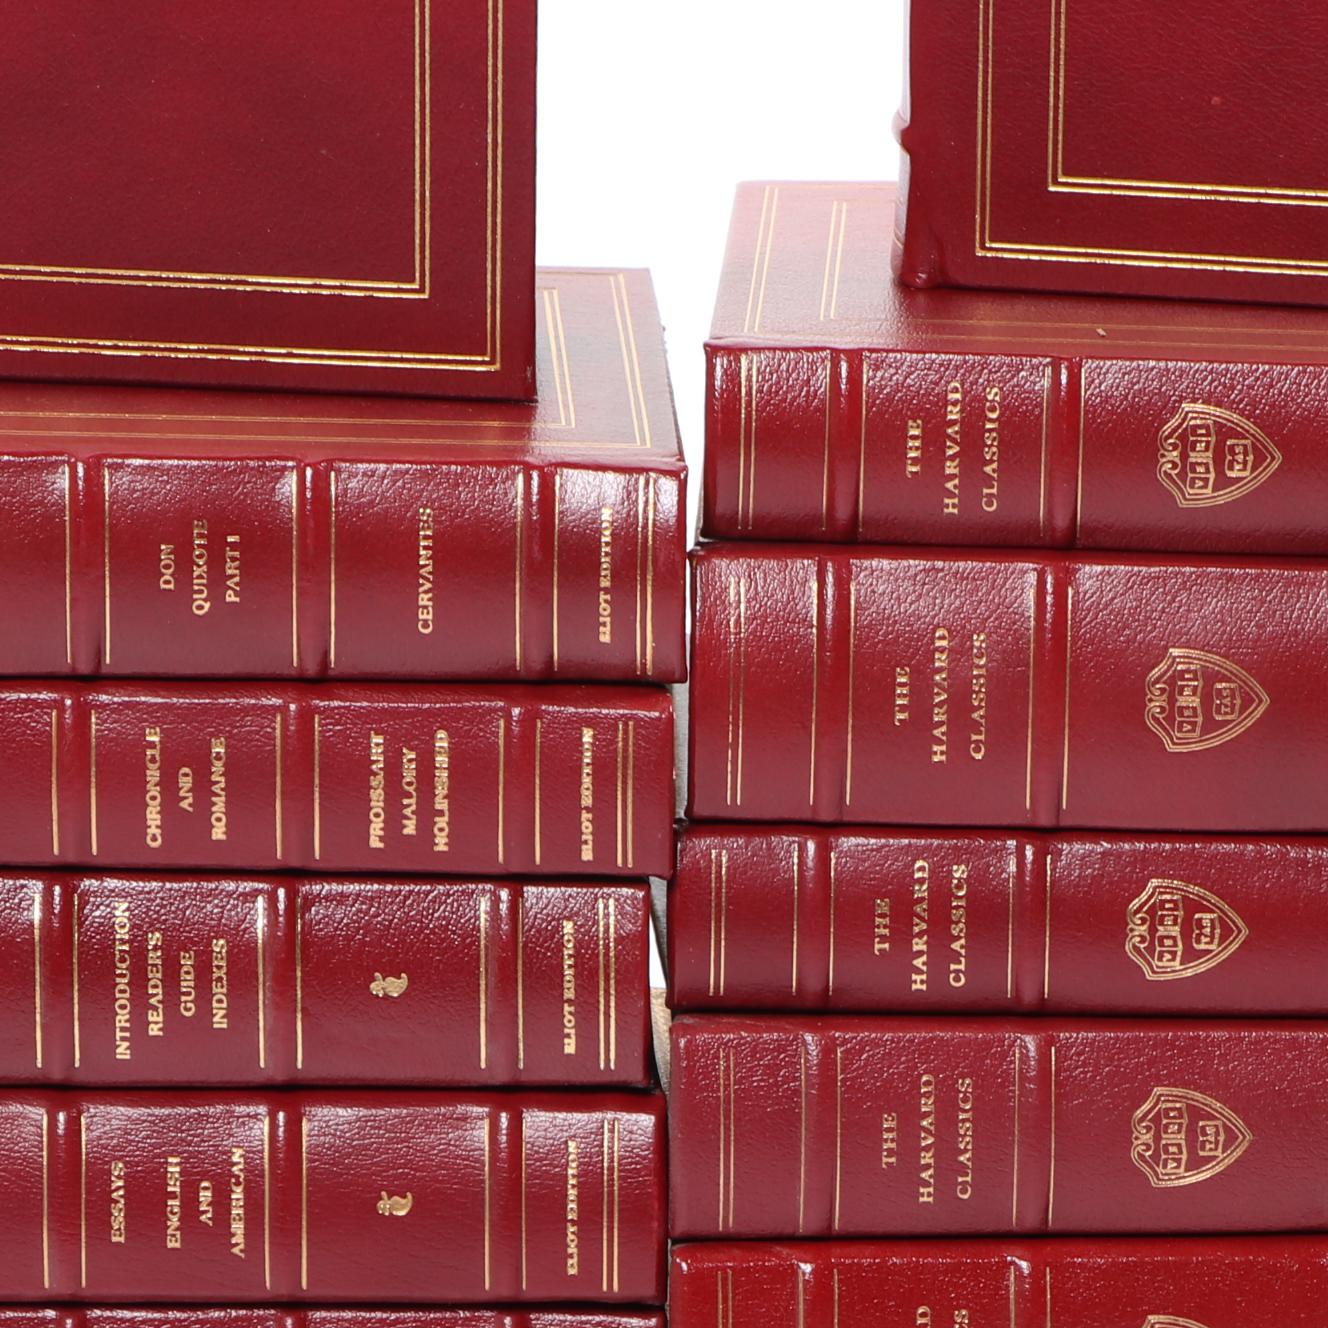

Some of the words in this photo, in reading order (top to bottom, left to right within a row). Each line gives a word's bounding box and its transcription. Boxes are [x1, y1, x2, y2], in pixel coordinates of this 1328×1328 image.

[905, 419, 923, 478] THE
[943, 379, 962, 515] HARVARD
[982, 386, 1000, 512] CLASSICS
[160, 544, 175, 590] DON
[192, 519, 210, 616] QUIXOTE
[225, 547, 241, 603] PART
[418, 507, 434, 634] CERVANTES
[893, 666, 911, 726] THE
[931, 627, 950, 764] HARVARD
[969, 633, 987, 760] CLASSICS
[145, 727, 162, 848] CHRONICLE
[178, 768, 193, 812] AND
[211, 738, 227, 840] ROMANCE
[369, 732, 385, 848] FROISSART
[402, 747, 417, 835] MALORY
[433, 730, 449, 851] HOLINSHED
[873, 898, 890, 955] THE
[911, 859, 929, 992] HARVARD
[949, 863, 968, 987] CLASSICS
[115, 901, 131, 1060] INTRODUCTION
[147, 932, 163, 1036] READER'S
[180, 951, 195, 1017] GUIDE
[212, 939, 228, 1029] INDEXES
[881, 1113, 897, 1168] THE
[919, 1074, 935, 1204] HARVARD
[956, 1077, 973, 1200] CLASSICS
[110, 1161, 125, 1243] ESSAYS
[166, 1156, 182, 1249] ENGLISH
[198, 1181, 214, 1226] AND
[230, 1147, 245, 1258] AMERICAN
